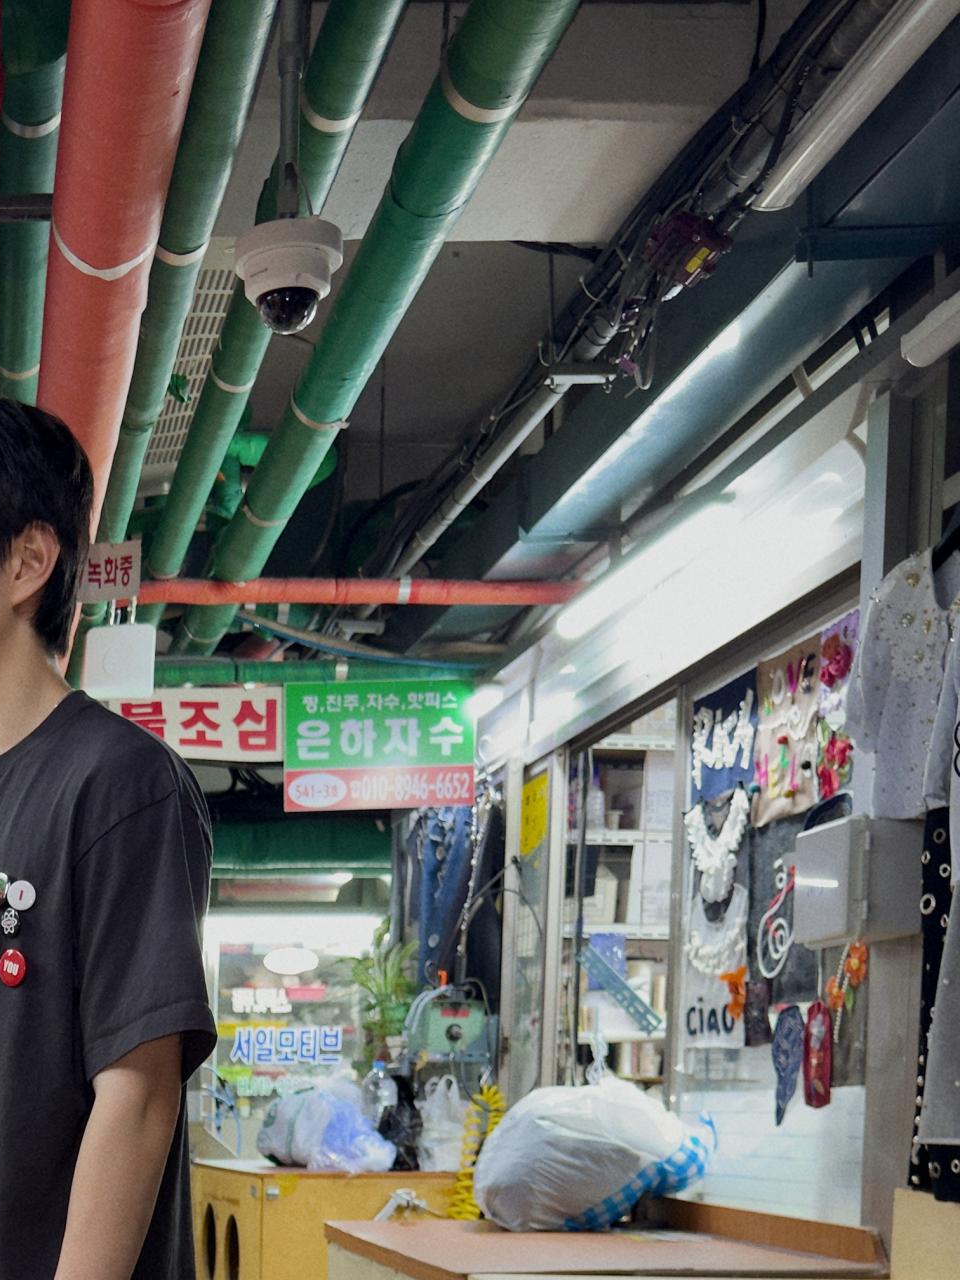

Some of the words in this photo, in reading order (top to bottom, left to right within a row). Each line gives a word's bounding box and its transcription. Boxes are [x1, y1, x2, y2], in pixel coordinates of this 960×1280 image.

[88, 555, 134, 589] 녹화중
[295, 716, 465, 761] 은하자수
[3, 959, 19, 976] YOU
